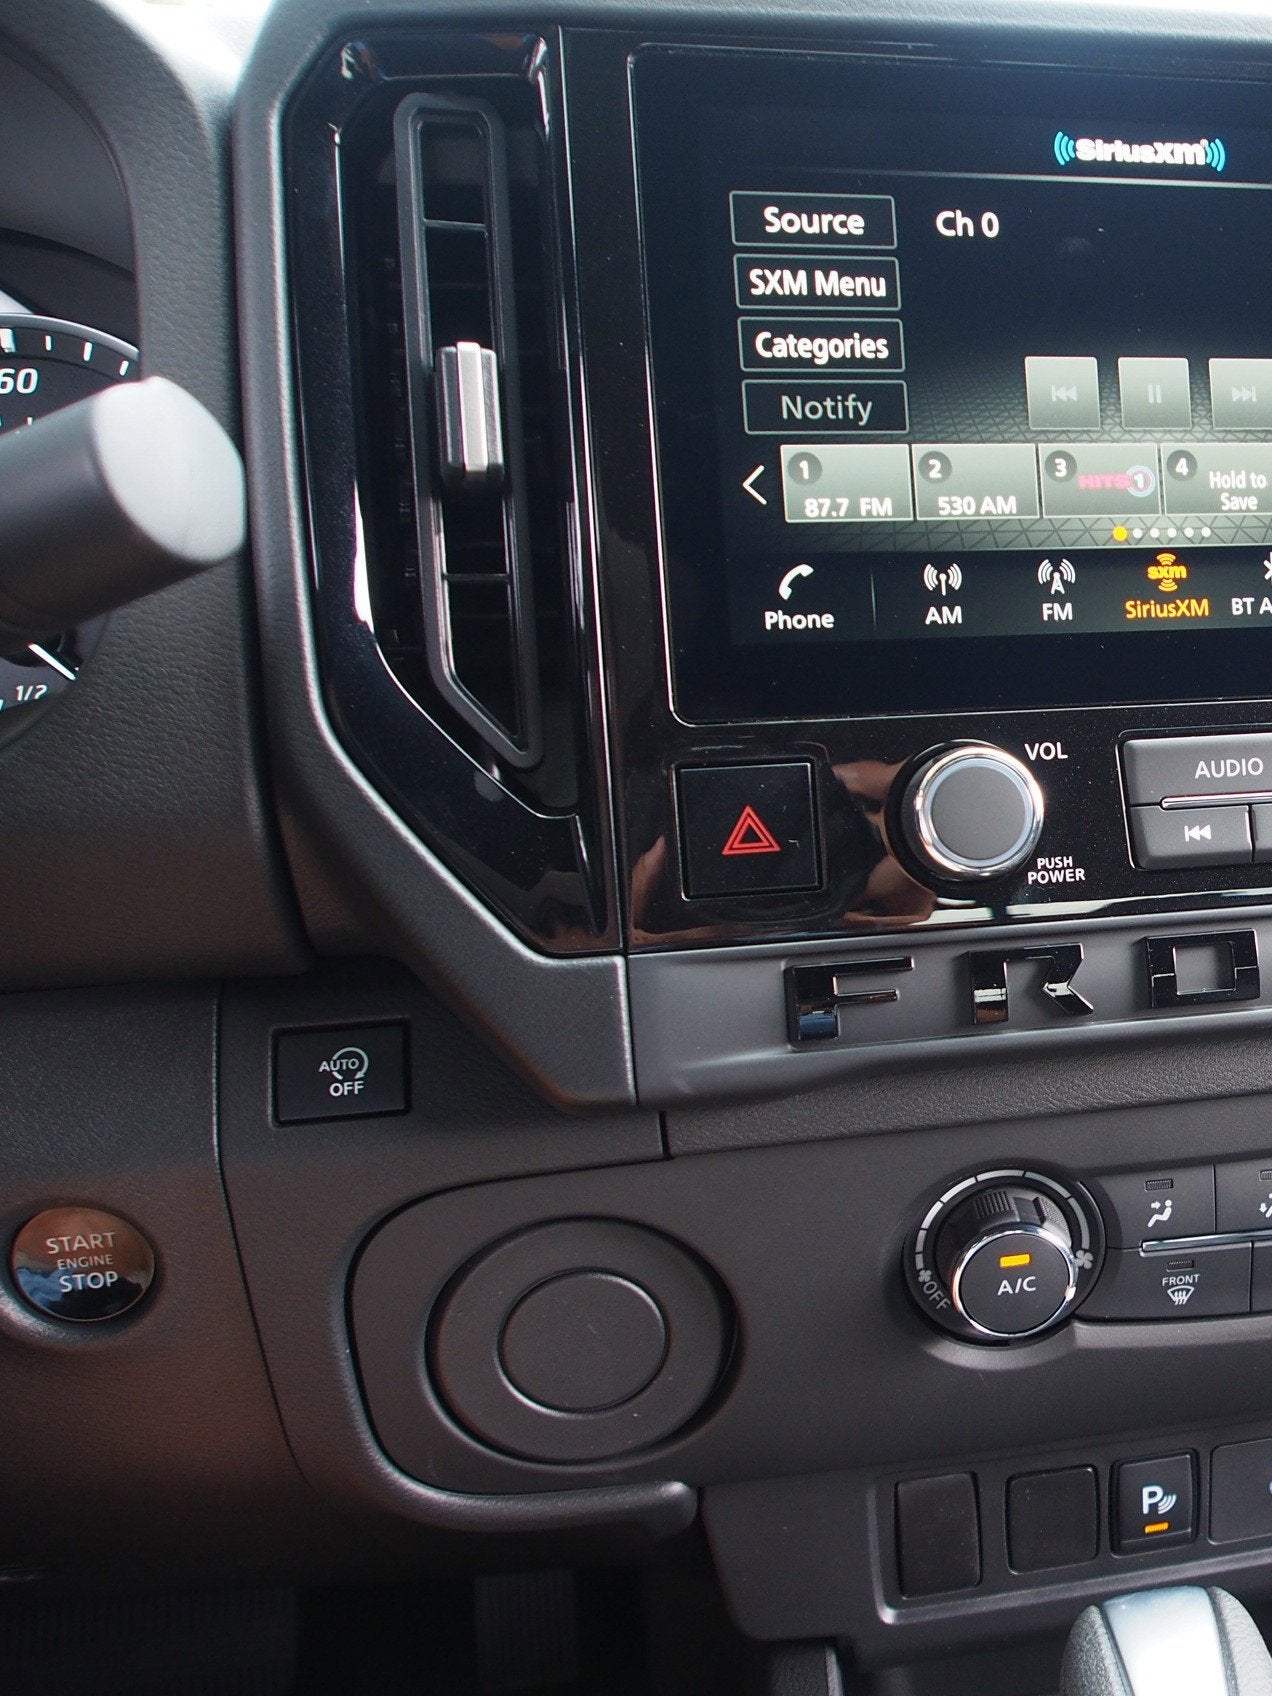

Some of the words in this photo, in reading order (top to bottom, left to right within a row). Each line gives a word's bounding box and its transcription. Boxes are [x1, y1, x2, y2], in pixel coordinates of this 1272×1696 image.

[763, 206, 865, 236] Source
[935, 210, 974, 237] Ch
[981, 211, 1000, 239] 0
[749, 269, 808, 296] SXM
[814, 270, 887, 297] Menu
[755, 332, 889, 365] Categories
[781, 394, 873, 426] Notify
[799, 460, 811, 479] 1
[928, 459, 942, 479] 2
[1054, 458, 1068, 478] 3
[1175, 458, 1189, 476] 4
[1209, 469, 1244, 488] Hold
[1248, 472, 1268, 489] to
[804, 497, 849, 517] 87.7
[859, 497, 893, 517] FM
[938, 496, 975, 515] 530
[980, 496, 1017, 515] AM
[1220, 493, 1258, 511] Save
[925, 605, 963, 625] AM
[1042, 603, 1073, 621] FM
[1125, 599, 1210, 619] SiriusXM
[1231, 598, 1256, 615] BT
[765, 611, 835, 630] Phone
[1024, 741, 1068, 761] VOL
[1194, 757, 1264, 780] AUDIO
[1036, 856, 1073, 870] PUSH
[1027, 868, 1086, 885] POWER
[318, 1057, 360, 1073] AUTO
[329, 1080, 365, 1097] OFF
[45, 1231, 116, 1255] START
[56, 1253, 114, 1271] ENGINE
[59, 1270, 119, 1294] STOP
[997, 1276, 1037, 1296] A/C
[1161, 1273, 1200, 1286] FRONT
[922, 1280, 952, 1310] OFF
